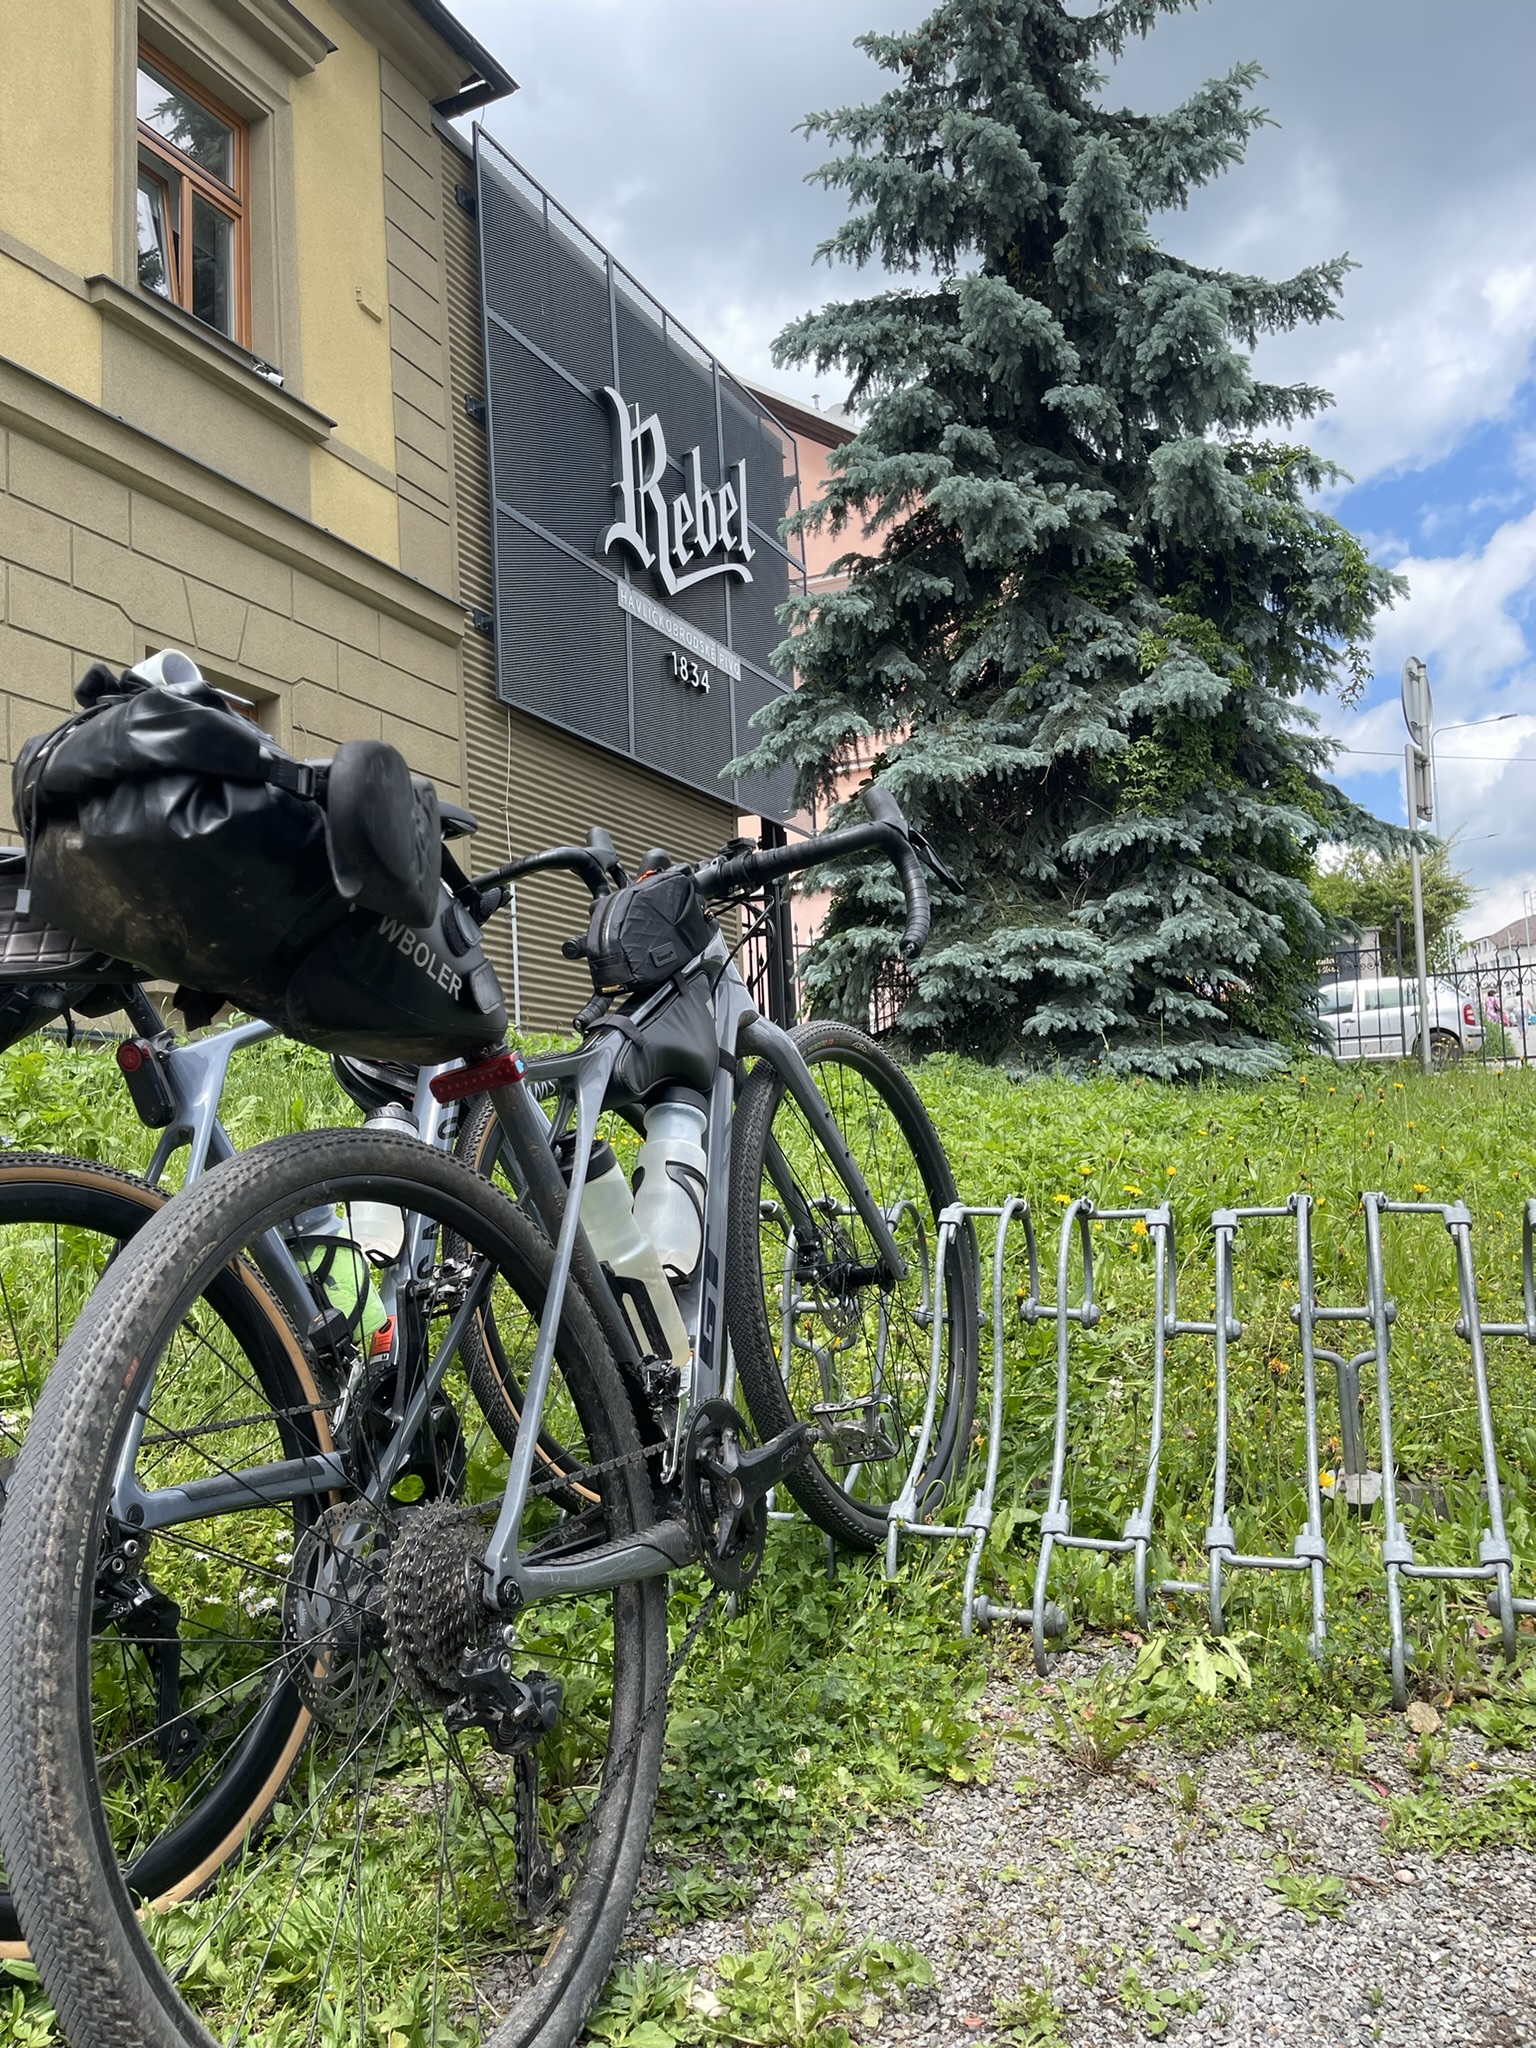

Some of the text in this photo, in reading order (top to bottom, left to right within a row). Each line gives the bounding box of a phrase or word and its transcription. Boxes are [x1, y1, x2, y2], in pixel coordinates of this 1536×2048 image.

[603, 386, 756, 596] Rebel
[671, 650, 711, 694] 1834
[718, 653, 740, 676] PIVO
[377, 916, 463, 1001] WBOLER
[781, 1441, 800, 1463] GRX
